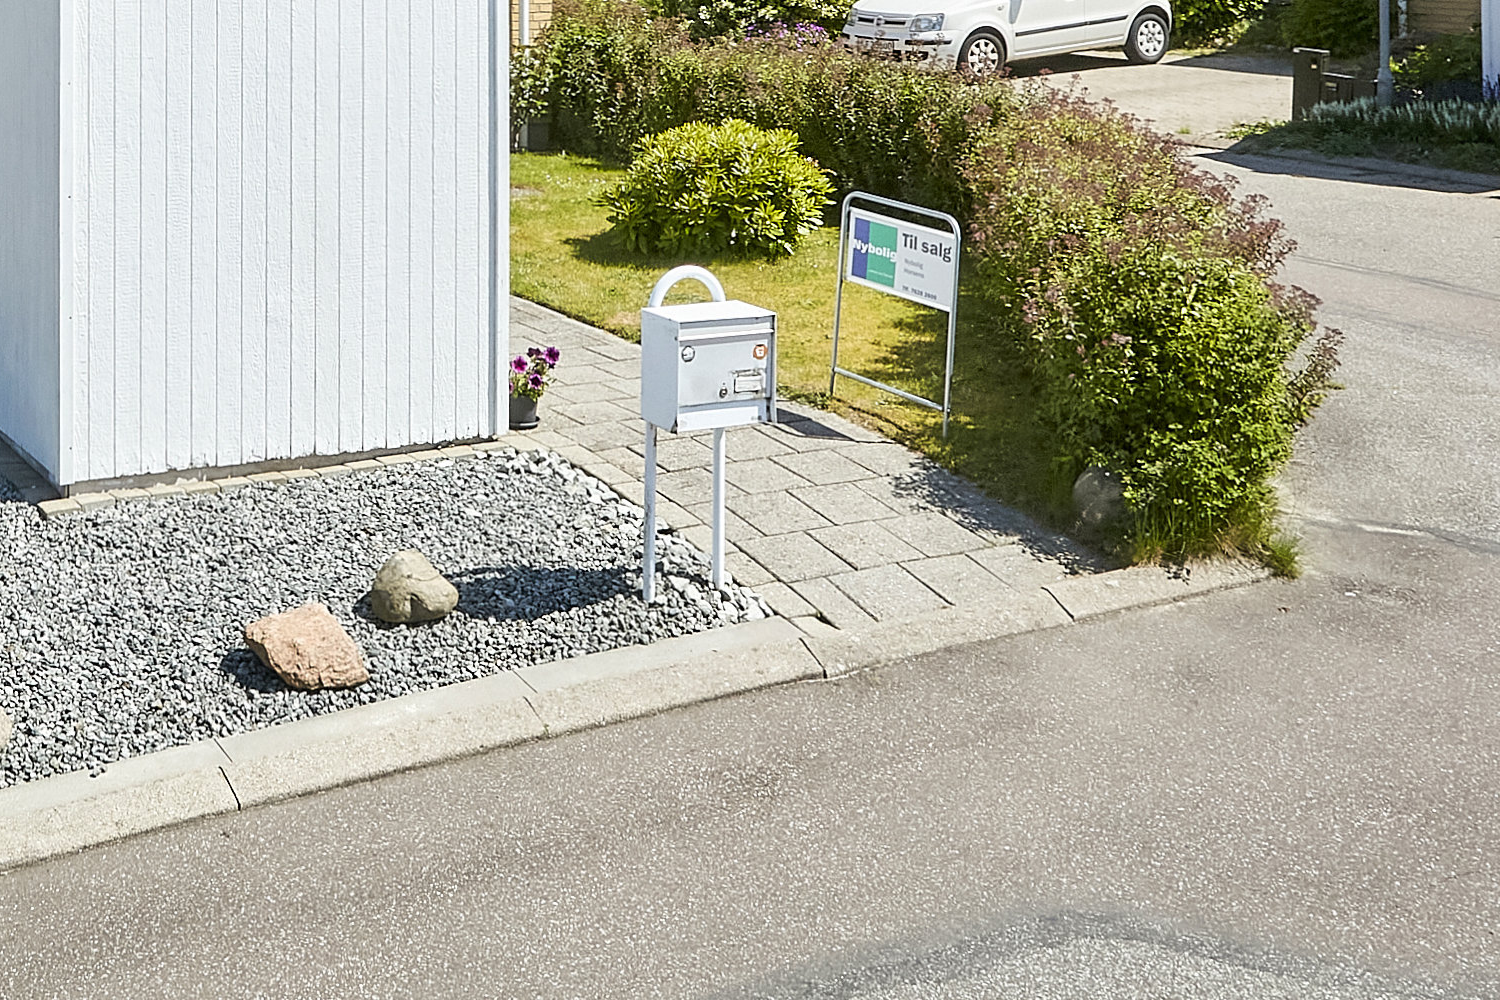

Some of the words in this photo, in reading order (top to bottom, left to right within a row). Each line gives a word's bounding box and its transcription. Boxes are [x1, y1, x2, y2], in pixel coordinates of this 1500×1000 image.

[853, 237, 897, 262] Nybolig
[902, 233, 917, 251] Til
[921, 241, 952, 263] salg
